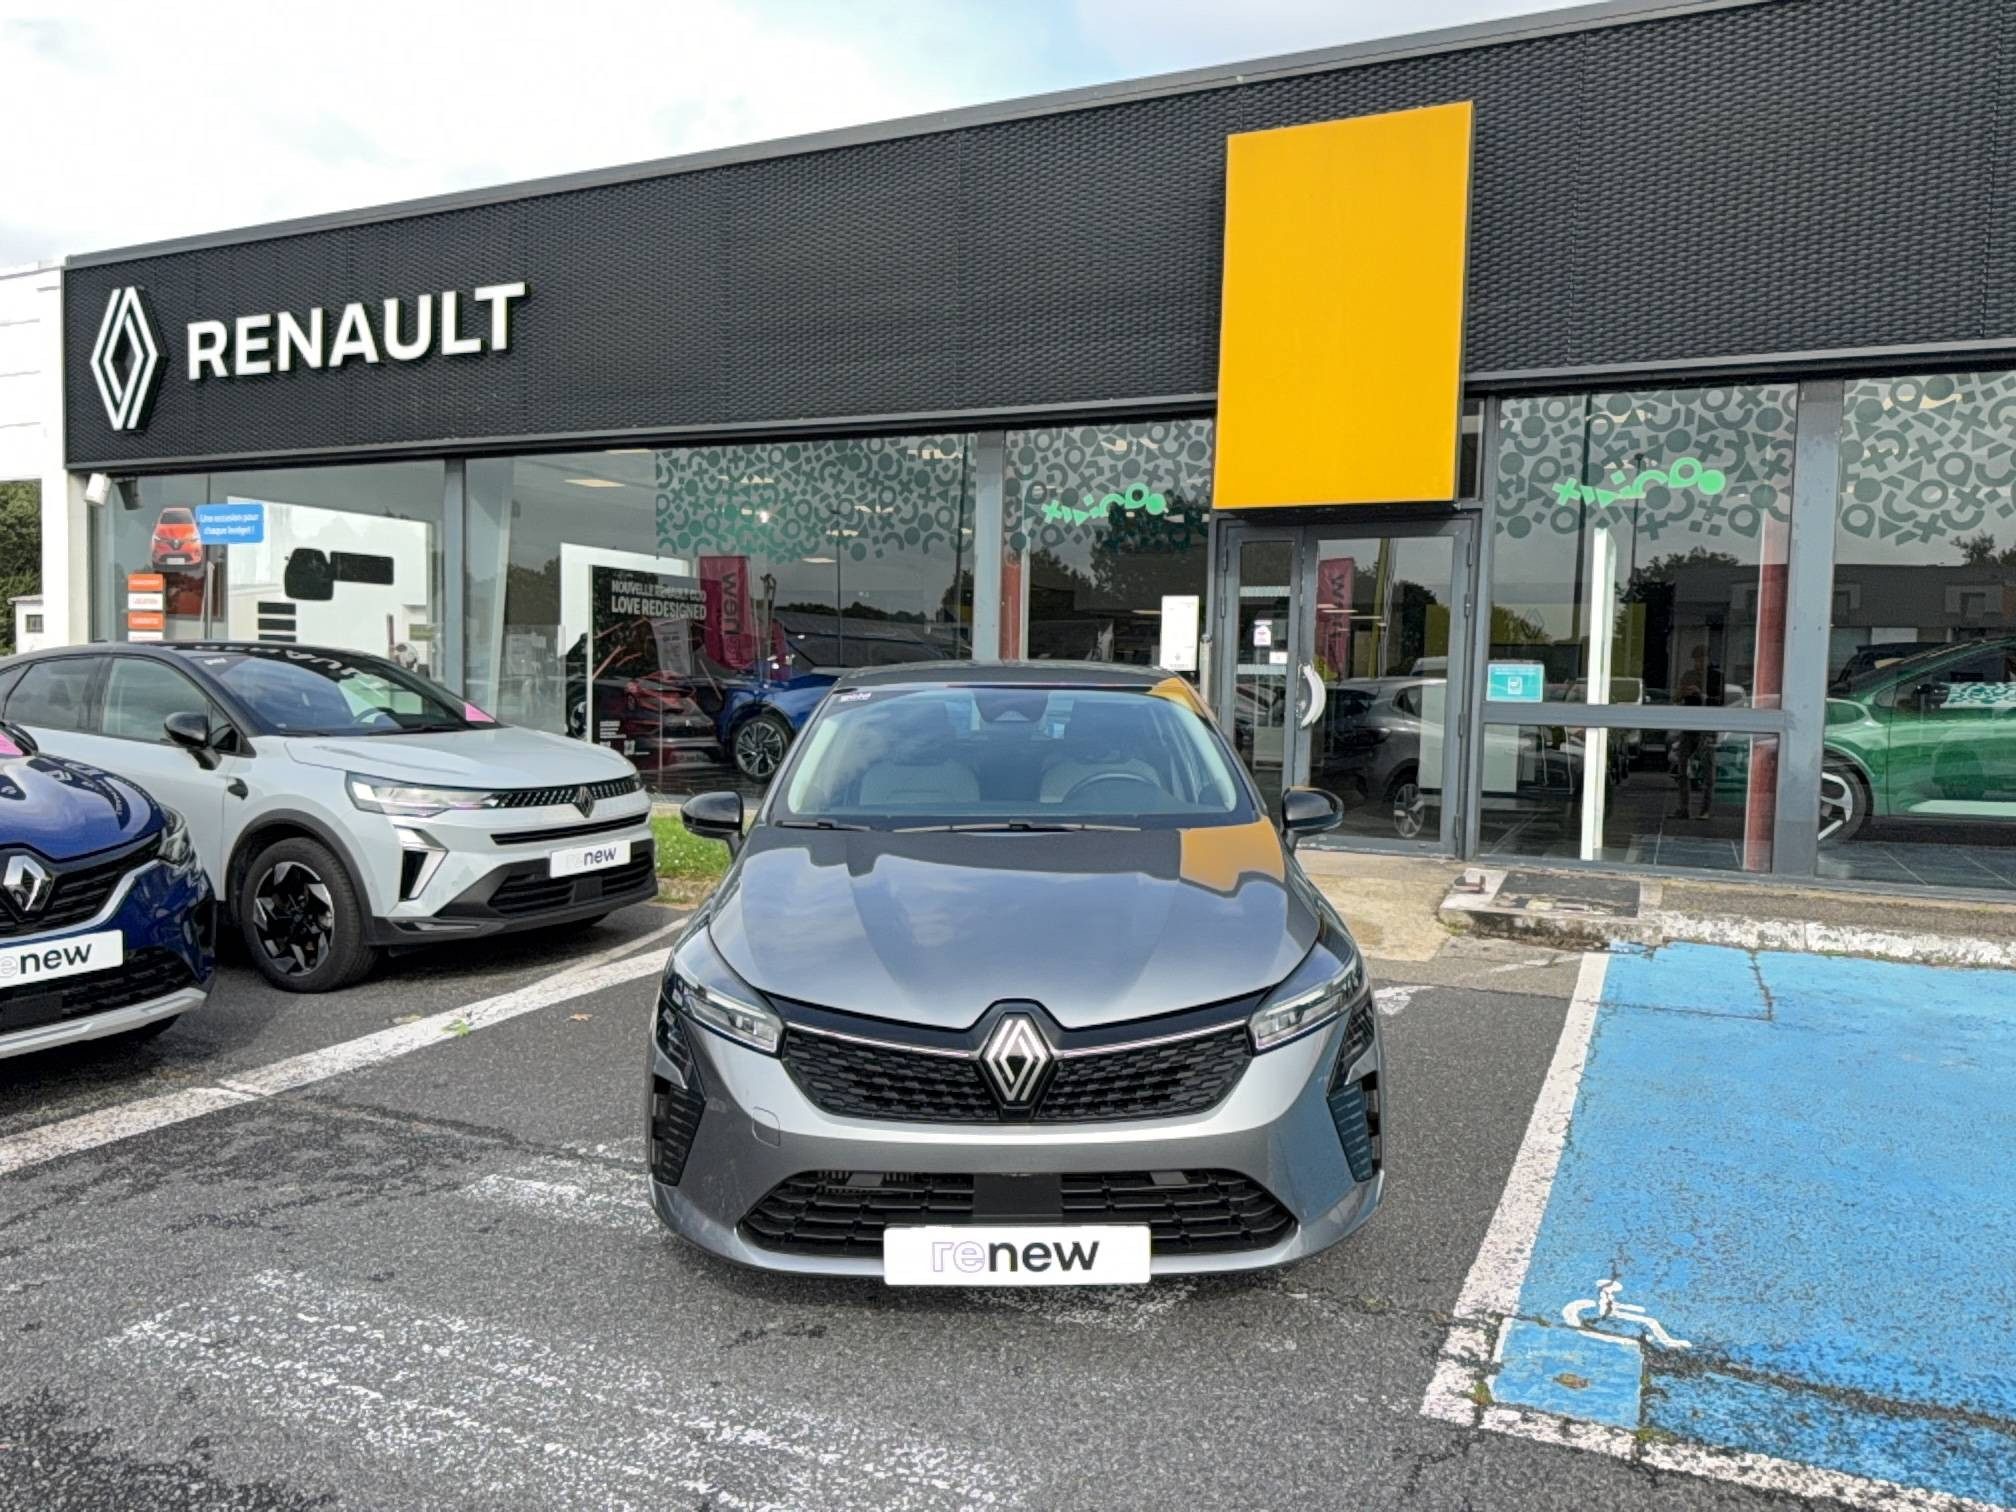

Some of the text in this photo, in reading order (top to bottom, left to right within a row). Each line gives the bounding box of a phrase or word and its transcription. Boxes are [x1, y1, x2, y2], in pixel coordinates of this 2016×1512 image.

[188, 282, 526, 380] RENAULT
[611, 580, 654, 597] NOUVELLE
[611, 595, 708, 621] LOVE REDESIGNED
[932, 1240, 1100, 1274] renew
